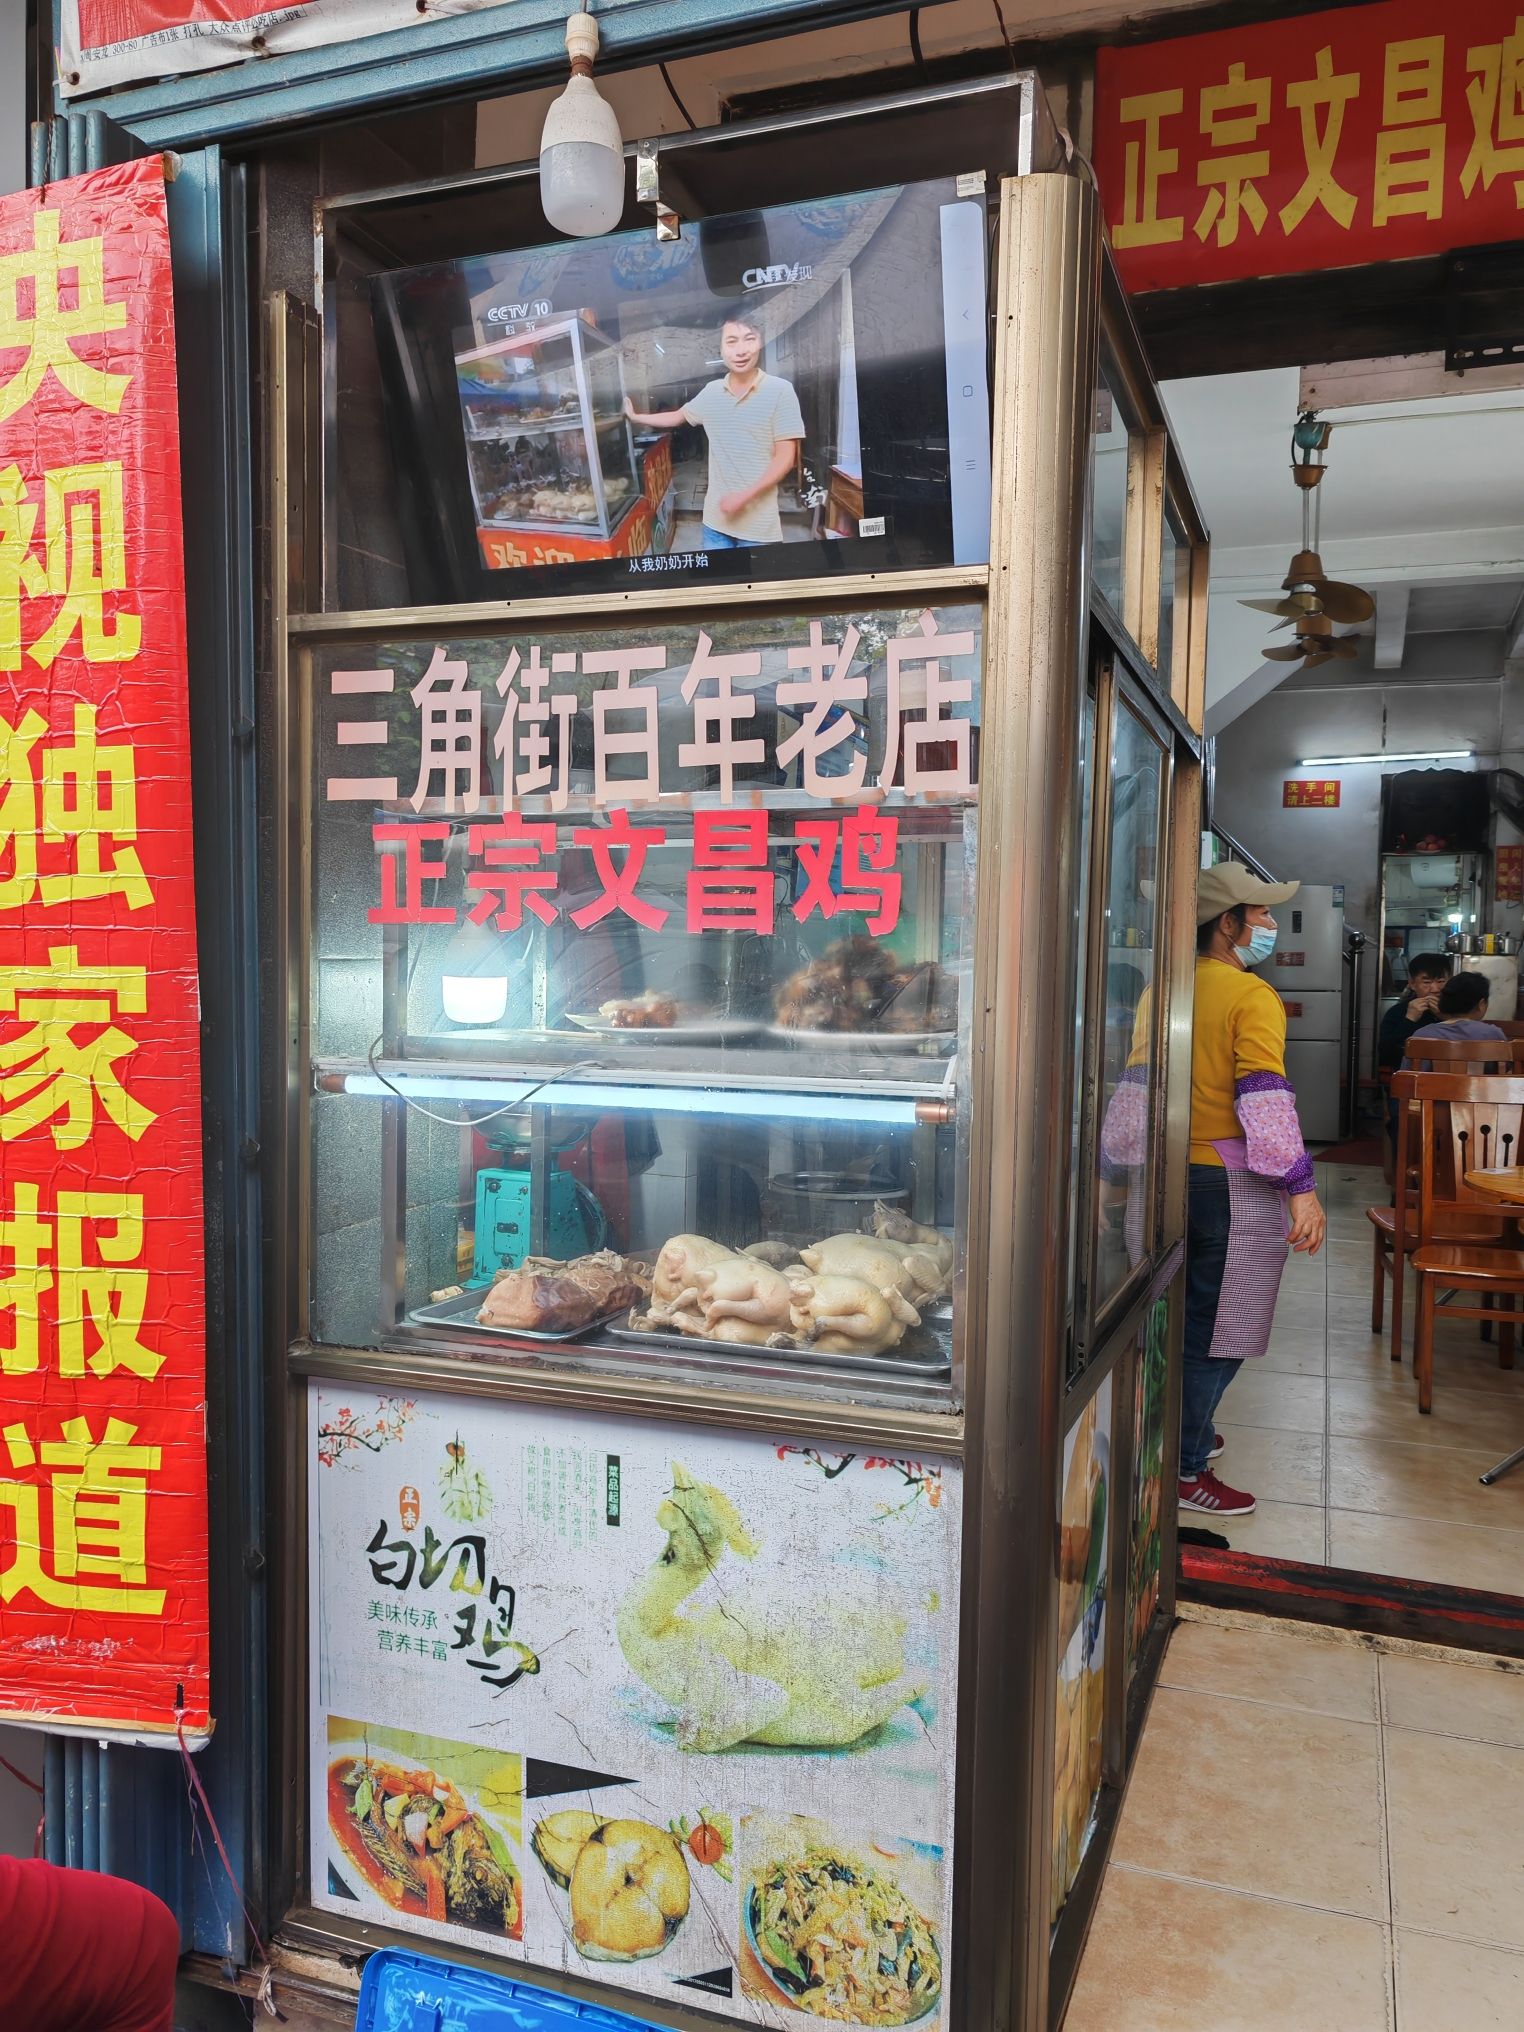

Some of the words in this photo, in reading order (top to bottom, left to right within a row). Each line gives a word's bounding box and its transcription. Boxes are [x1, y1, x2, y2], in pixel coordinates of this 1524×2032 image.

[183, 22, 206, 40] 打孔
[1112, 15, 1524, 249] 正宗文昌鸡
[487, 303, 528, 321] CCTV
[535, 302, 548, 316] 10
[628, 552, 709, 573] 从我奶奶开始
[327, 608, 975, 814] 三角街百年老店
[1287, 782, 1336, 793] 洗手间
[367, 804, 901, 936] 正宗文昌鸡
[0, 208, 167, 1616] 央视独家报道
[402, 1486, 418, 1528] 正宗
[366, 1519, 540, 1688] 白切鸡
[367, 1599, 438, 1630] 美味传承
[377, 1629, 448, 1662] 营养丰富
